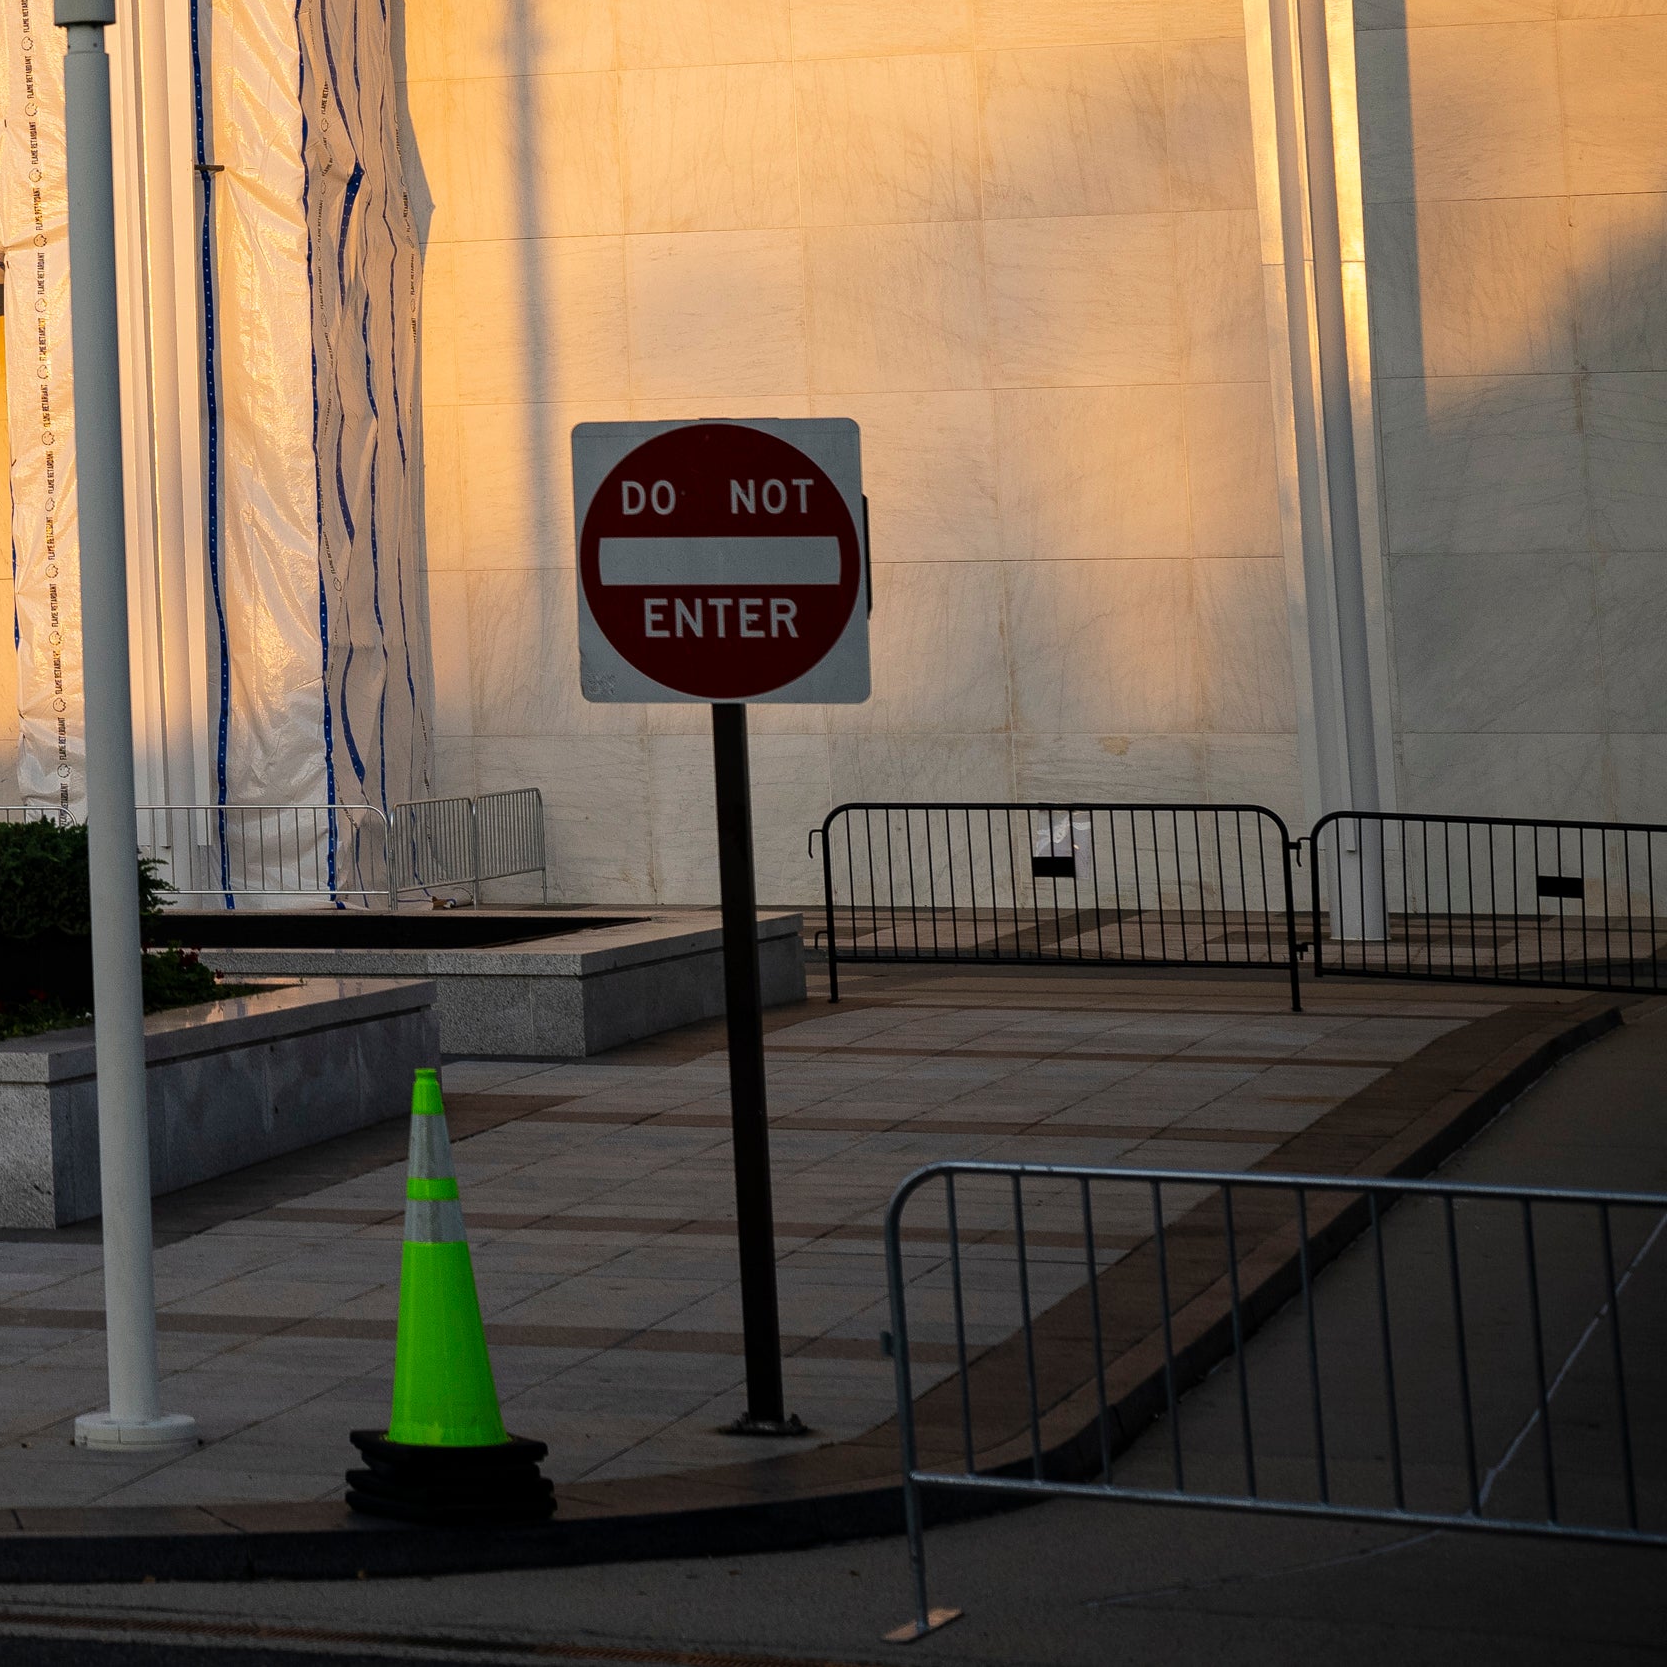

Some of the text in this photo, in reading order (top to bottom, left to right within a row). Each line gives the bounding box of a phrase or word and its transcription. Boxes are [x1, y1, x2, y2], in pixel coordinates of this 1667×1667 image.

[621, 479, 814, 515] DO NOT
[643, 598, 799, 638] ENTER
